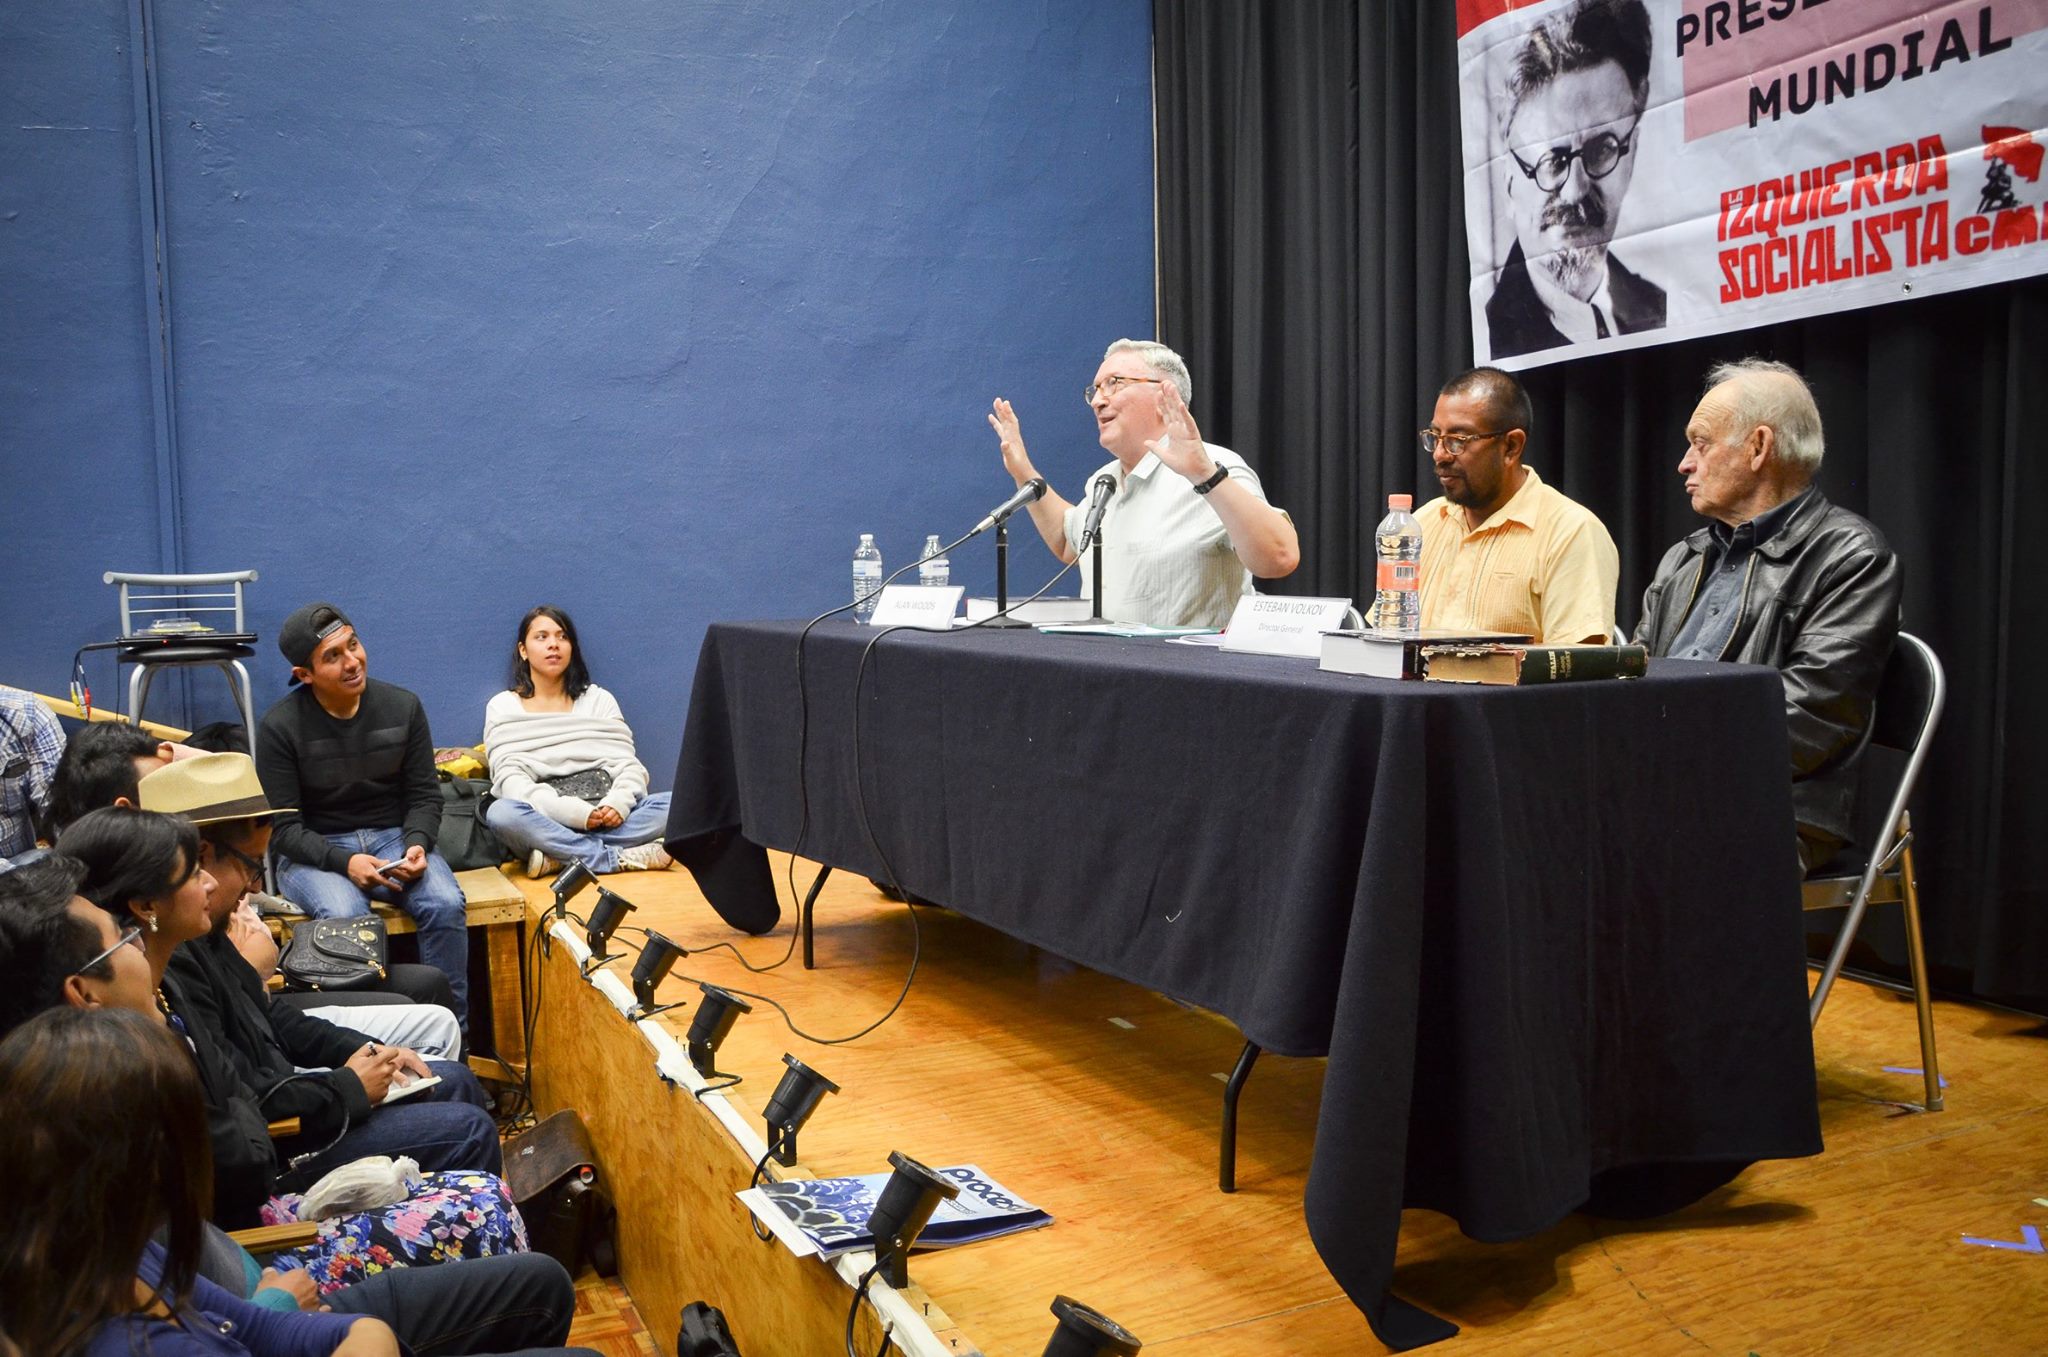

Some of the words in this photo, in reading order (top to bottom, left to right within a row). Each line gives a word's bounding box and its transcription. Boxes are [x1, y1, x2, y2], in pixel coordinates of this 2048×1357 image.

[1677, 0, 1830, 58] PRES
[1748, 6, 2013, 129] MUNDIAL
[1717, 134, 1949, 242] IZQUIERDA
[1728, 190, 1743, 204] LA
[1718, 200, 1949, 304] SOCIALISTA
[1253, 600, 1291, 613] ESTEBAN
[1291, 603, 1327, 615] VOLKOV
[1258, 622, 1280, 633] Director
[1280, 624, 1304, 634] General
